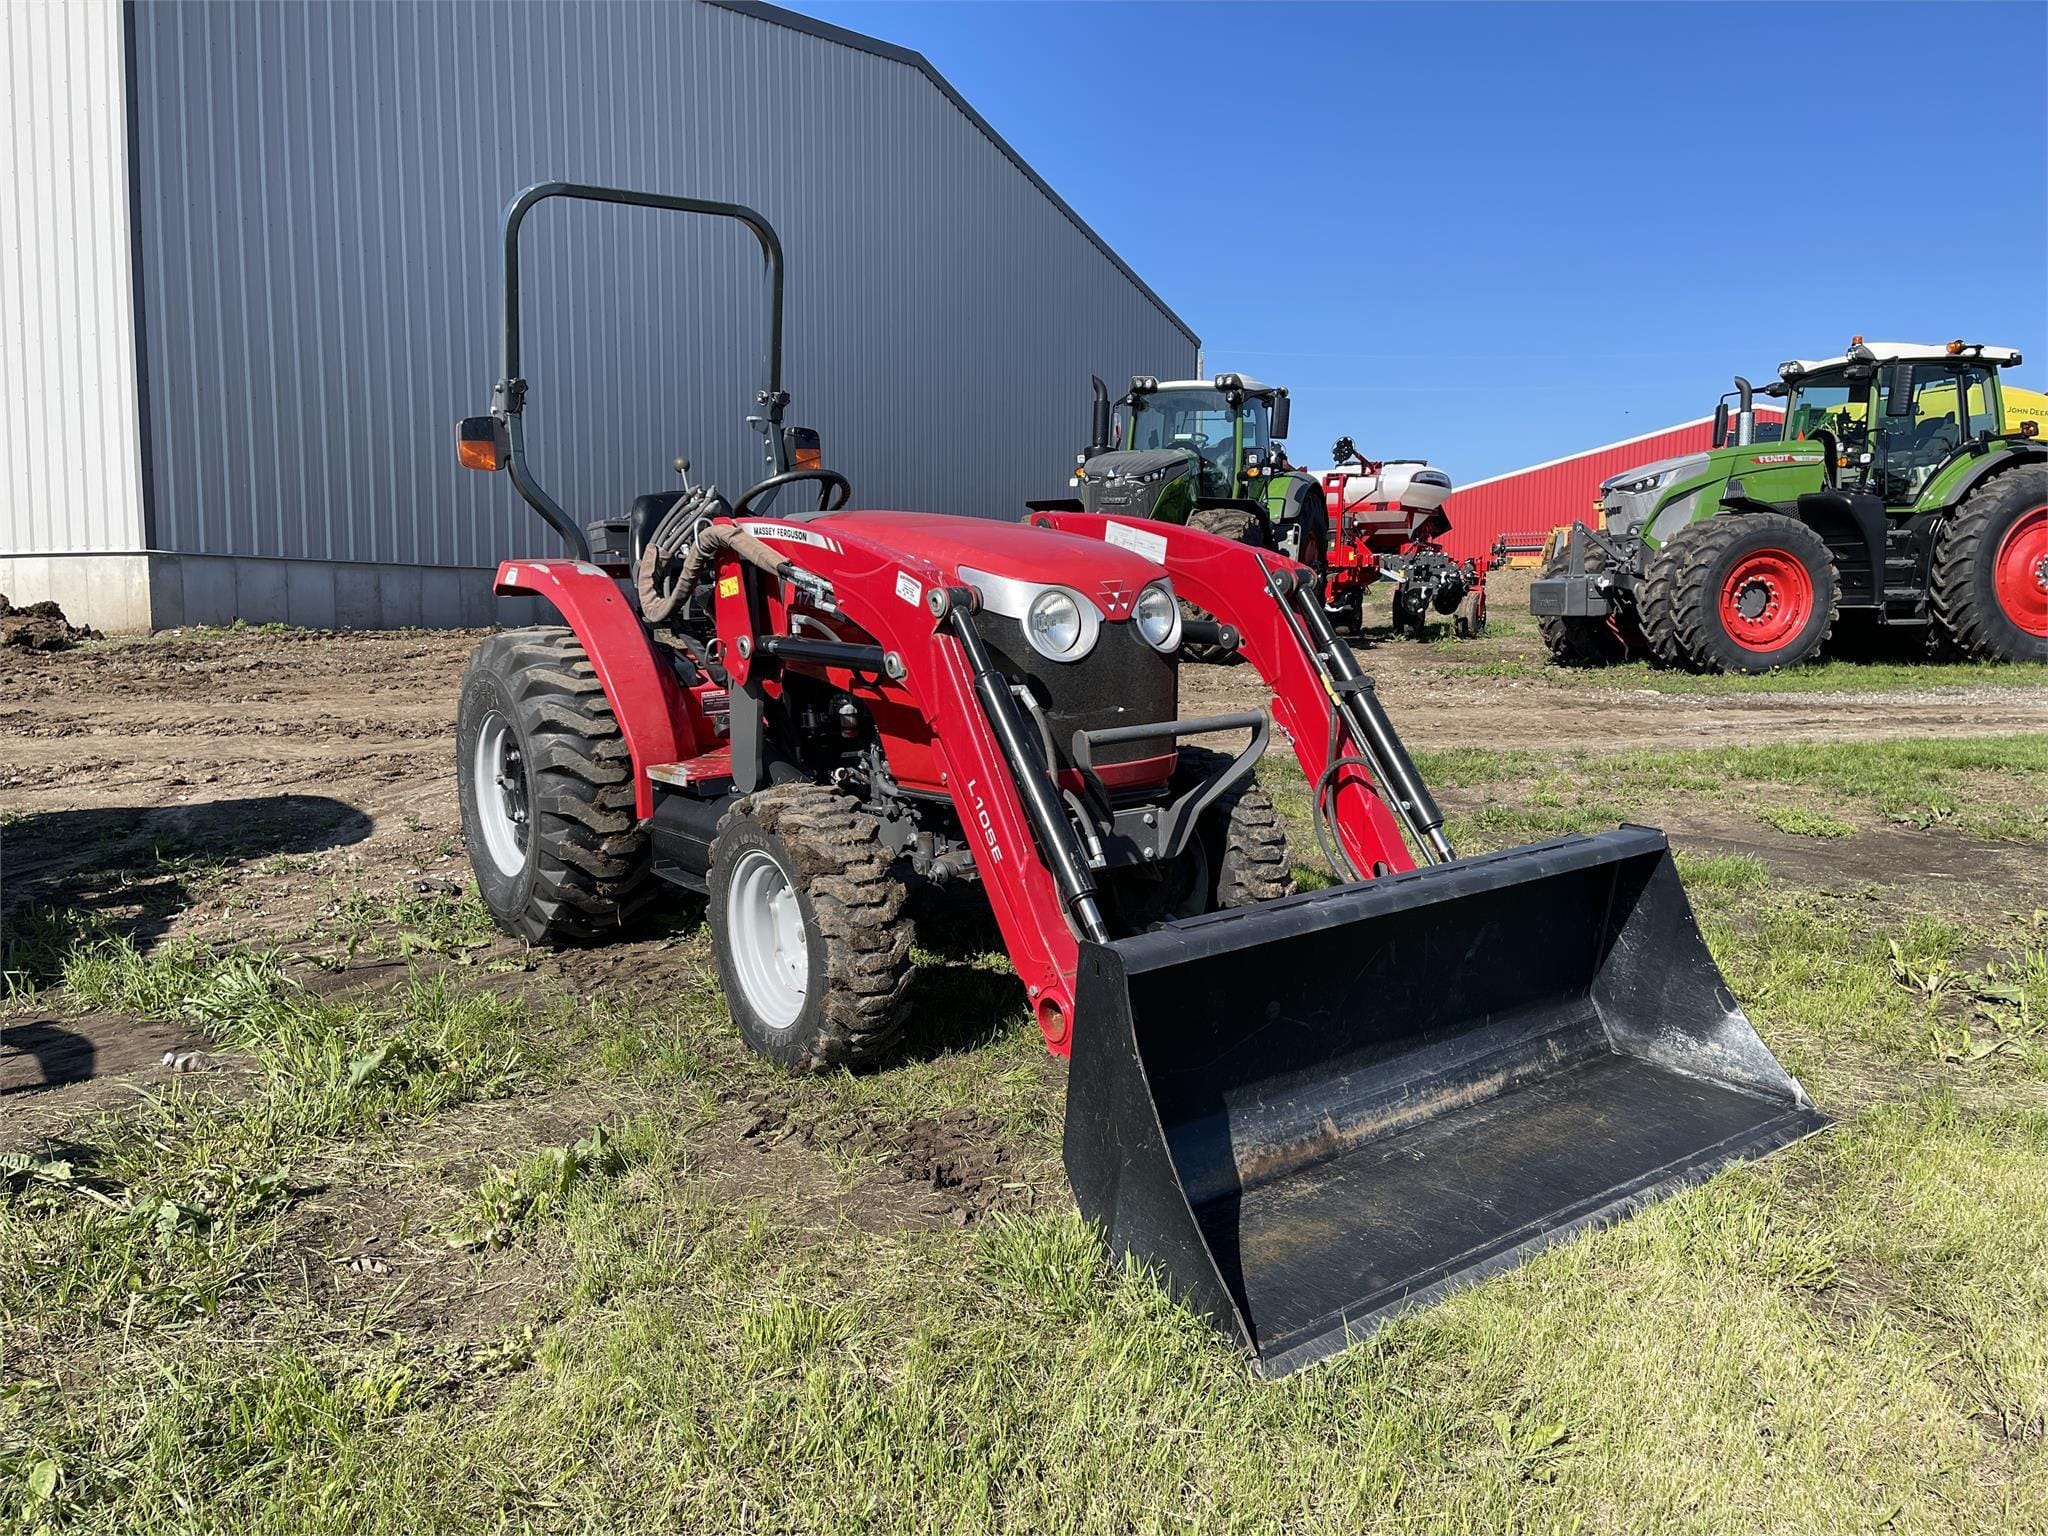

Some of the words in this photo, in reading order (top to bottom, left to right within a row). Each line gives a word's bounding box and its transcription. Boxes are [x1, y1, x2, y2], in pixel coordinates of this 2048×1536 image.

[2007, 406, 2028, 414] JOHN
[1759, 454, 1790, 464] FENDT
[753, 527, 776, 536] MASSEY
[777, 528, 807, 541] FERGUSON
[968, 779, 1003, 864] L105E
